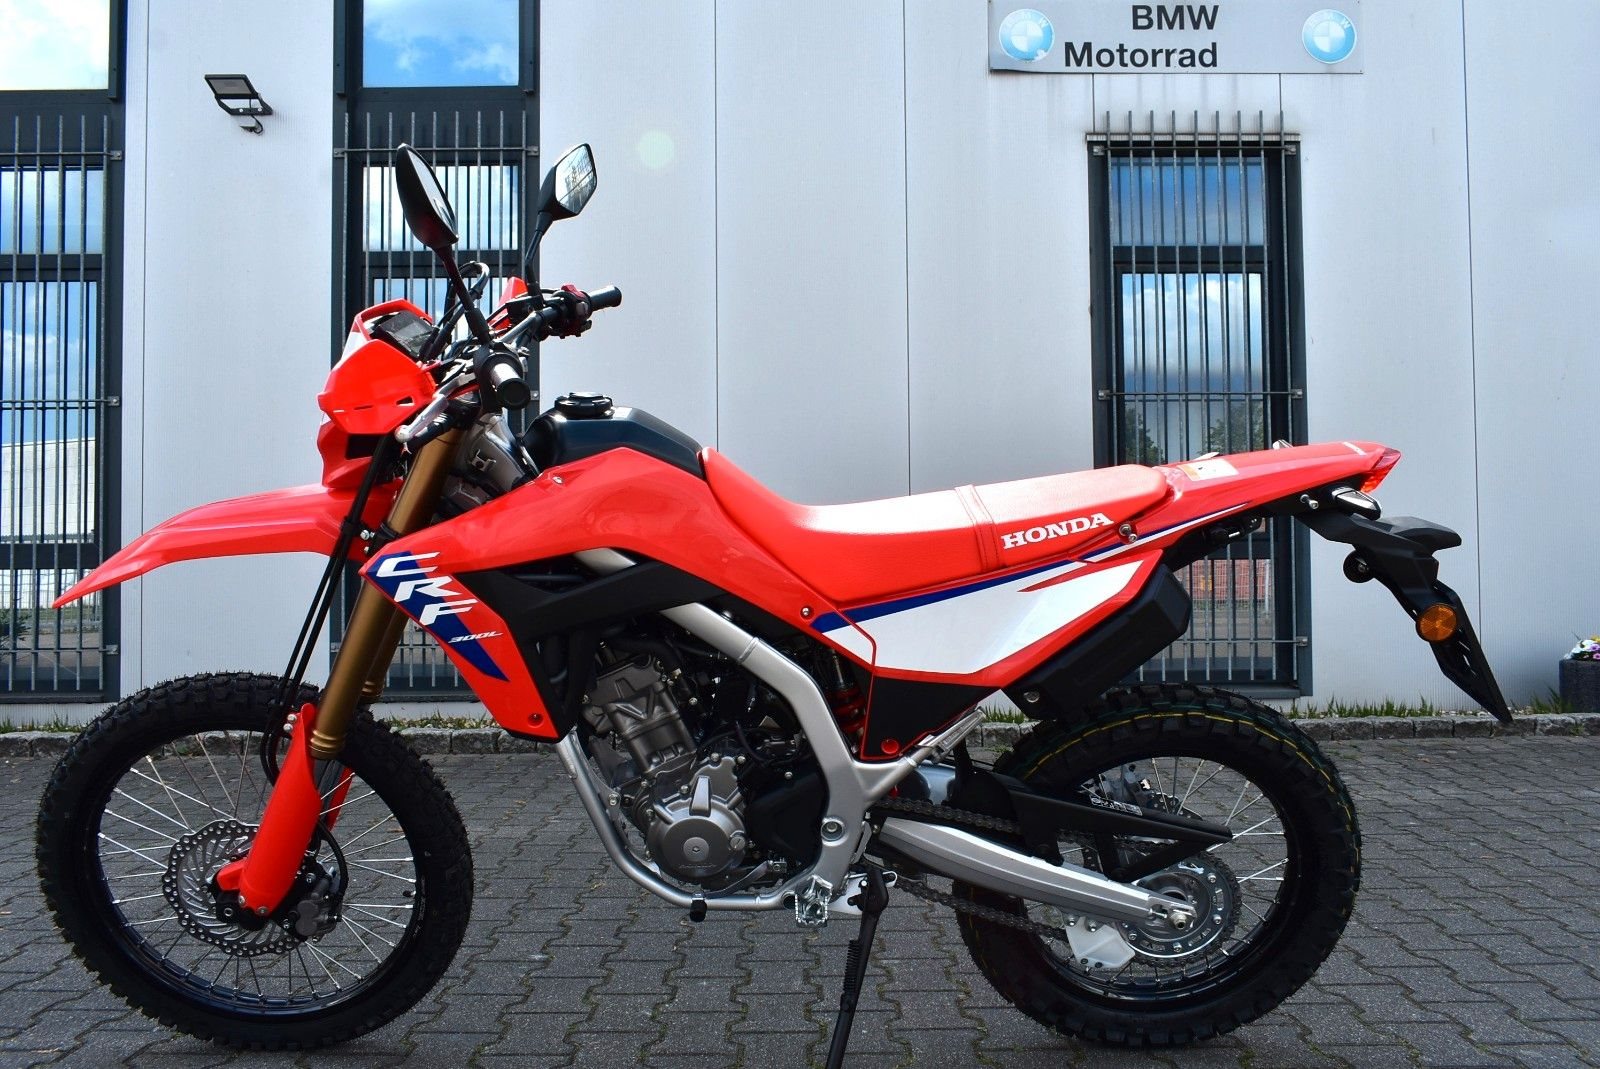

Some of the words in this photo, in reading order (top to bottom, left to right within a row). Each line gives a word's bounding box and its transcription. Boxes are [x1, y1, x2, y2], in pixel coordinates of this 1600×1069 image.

[1132, 5, 1219, 30] BMW
[1065, 42, 1217, 67] Motorrad
[1001, 513, 1114, 549] HONDA
[376, 551, 479, 626] CRF
[447, 631, 503, 643] 300L
